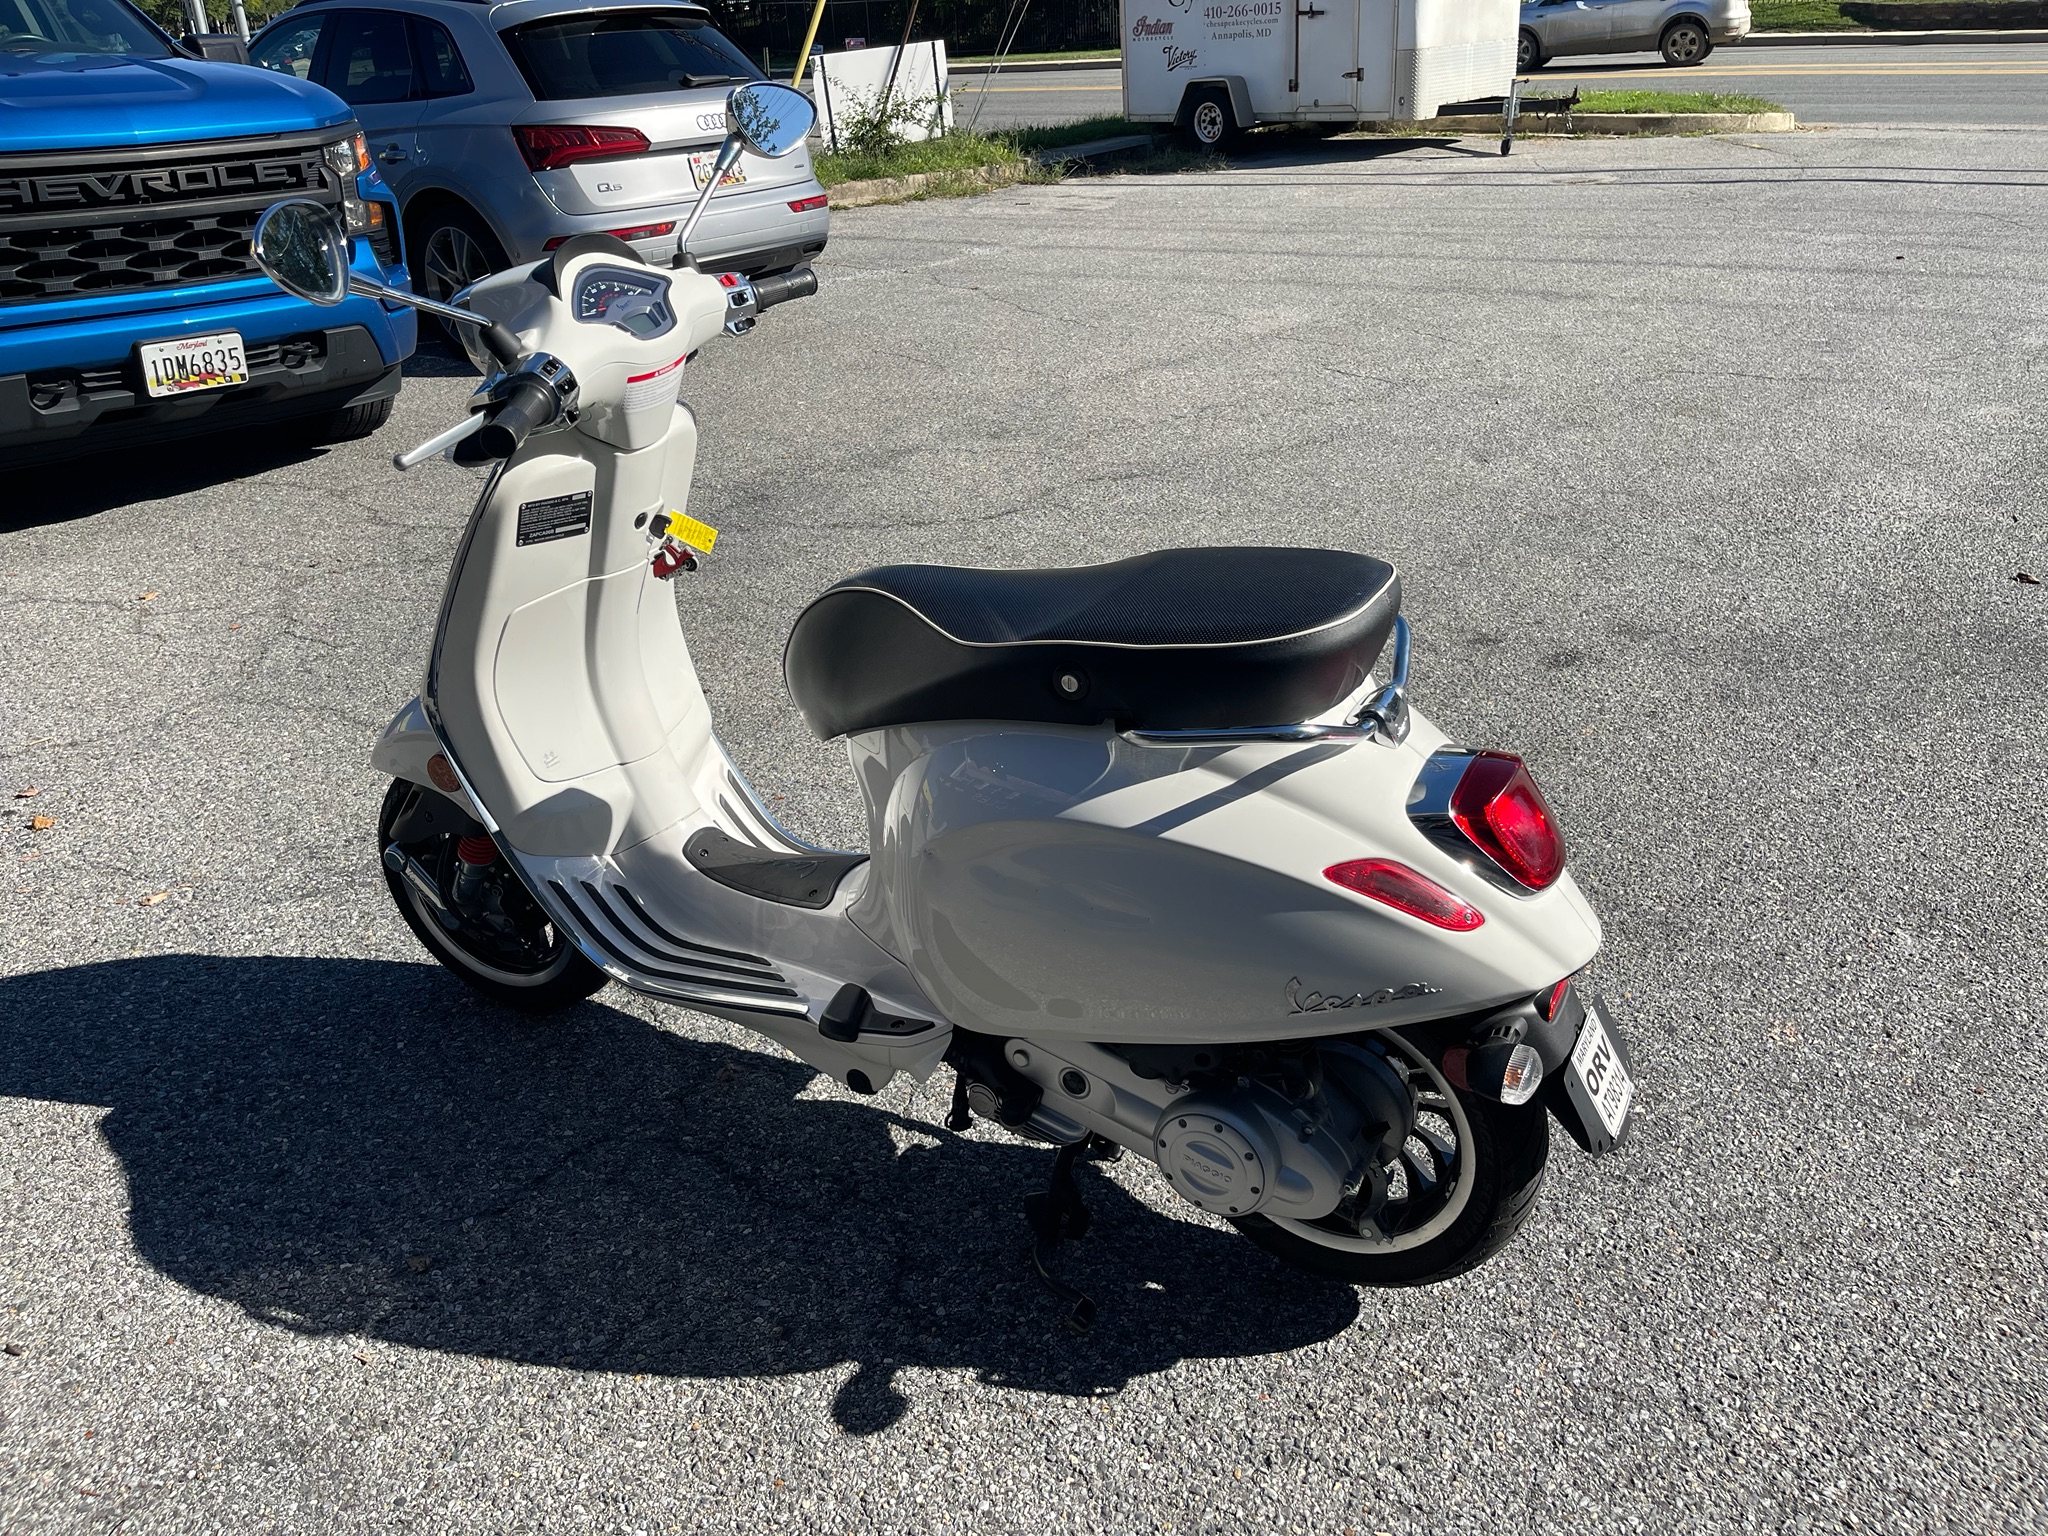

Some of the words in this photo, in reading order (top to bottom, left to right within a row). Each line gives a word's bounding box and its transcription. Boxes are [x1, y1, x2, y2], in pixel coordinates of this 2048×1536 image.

[1204, 2, 1282, 19] 410-266-0015
[1206, 17, 1279, 29] chesapeakecycles.com
[1133, 15, 1174, 37] Indian
[1211, 29, 1254, 42] Annapolis,
[1255, 28, 1272, 38] MD
[1163, 45, 1198, 70] Victory
[0, 156, 323, 207] HEVROLET
[597, 182, 623, 193] Q5
[176, 340, 208, 351] Maryland
[151, 347, 241, 387] 1DM6835
[1285, 975, 1443, 1018] Vespa
[1576, 1018, 1598, 1067] MARYLAND
[1586, 1034, 1611, 1097] ORV
[1602, 1063, 1628, 1126] AT98314
[1182, 1153, 1232, 1183] PIAGGIO
